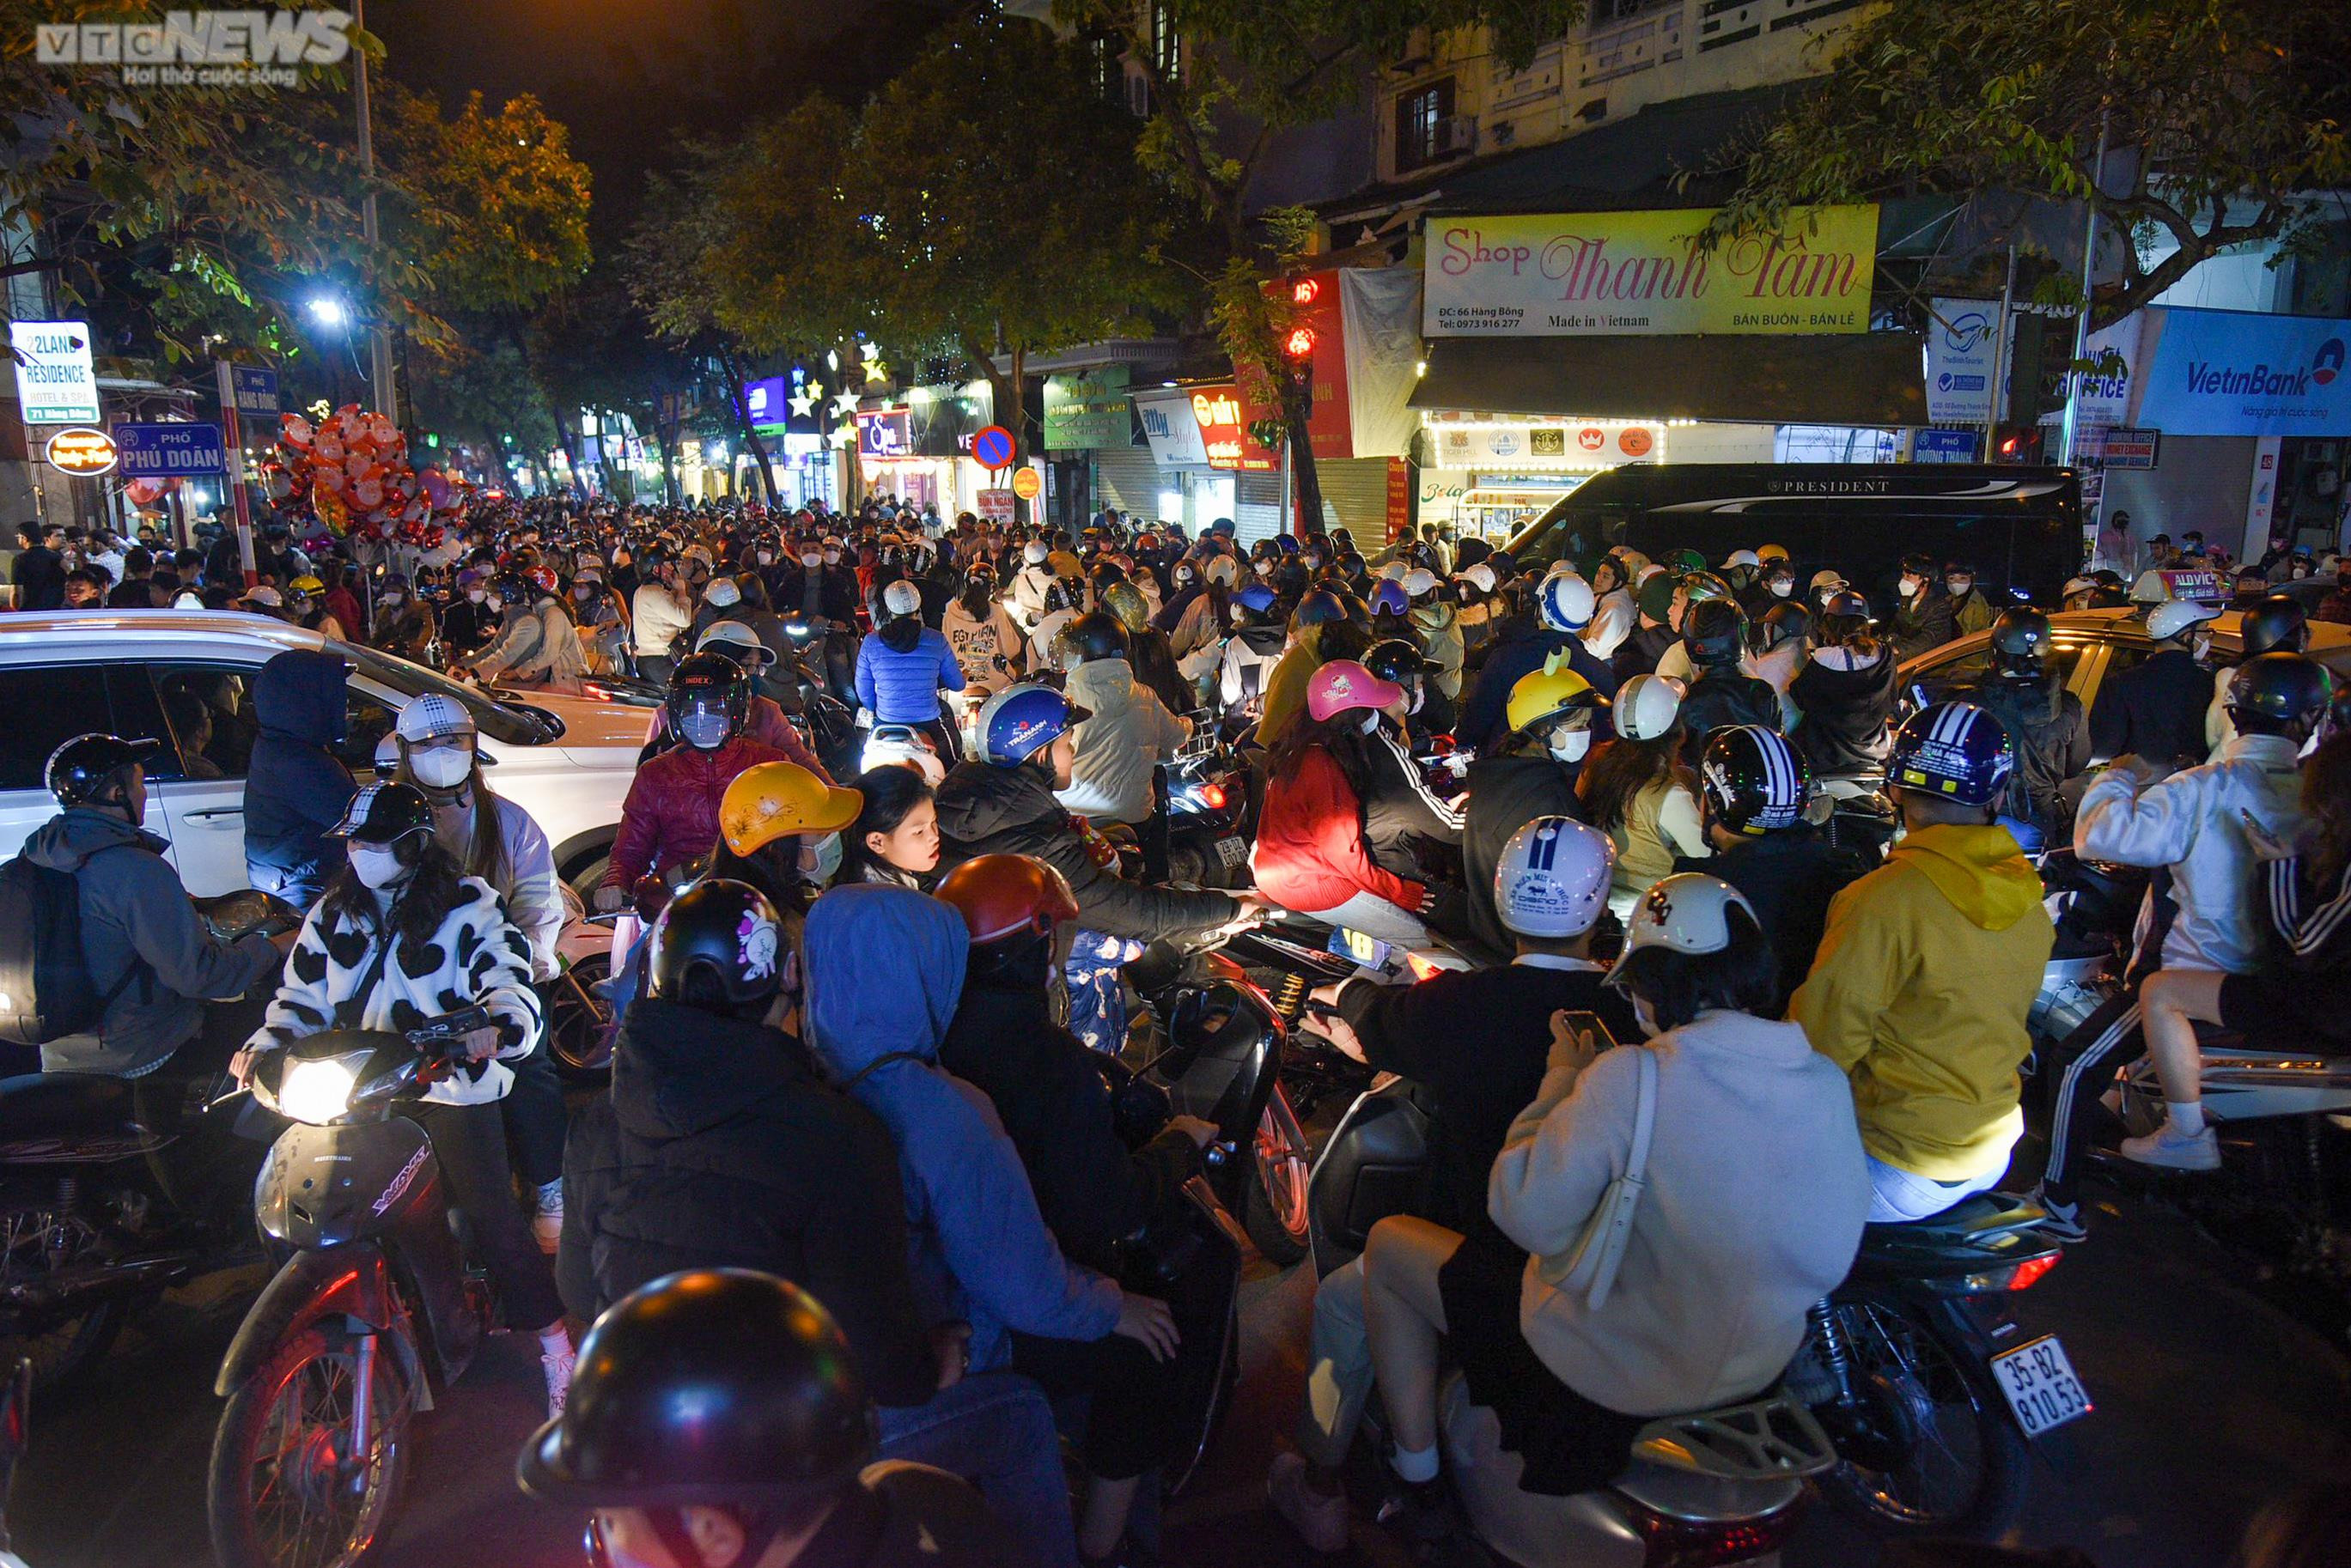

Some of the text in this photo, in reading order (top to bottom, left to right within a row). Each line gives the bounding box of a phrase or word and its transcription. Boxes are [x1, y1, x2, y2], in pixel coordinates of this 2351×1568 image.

[1440, 228, 1530, 276] Shop
[1540, 229, 1858, 301] Thanh Tâm
[1439, 307, 1455, 316] ĐC:
[1471, 307, 1496, 318] Hàng
[1499, 307, 1524, 317] Bông
[1548, 314, 1648, 327] Made in Vietnam
[1733, 313, 1759, 325] BÁN
[1763, 312, 1799, 325] BUÔN
[1810, 311, 1836, 325] BÁN
[1840, 311, 1855, 325] LẺ
[1457, 319, 1479, 328] 0973
[27, 365, 86, 383] RESIDENCE
[2188, 362, 2311, 396] VietinBank
[1142, 408, 1169, 439] My
[161, 430, 192, 444] PHỐ
[1941, 435, 1959, 446] PHỐ
[123, 444, 220, 468] PHỦ DOÃN
[1784, 481, 1890, 492] PRESIDENT
[685, 677, 709, 685] INDEX
[2004, 1344, 2062, 1391] 35-B2
[2017, 1377, 2086, 1430] 810.53
